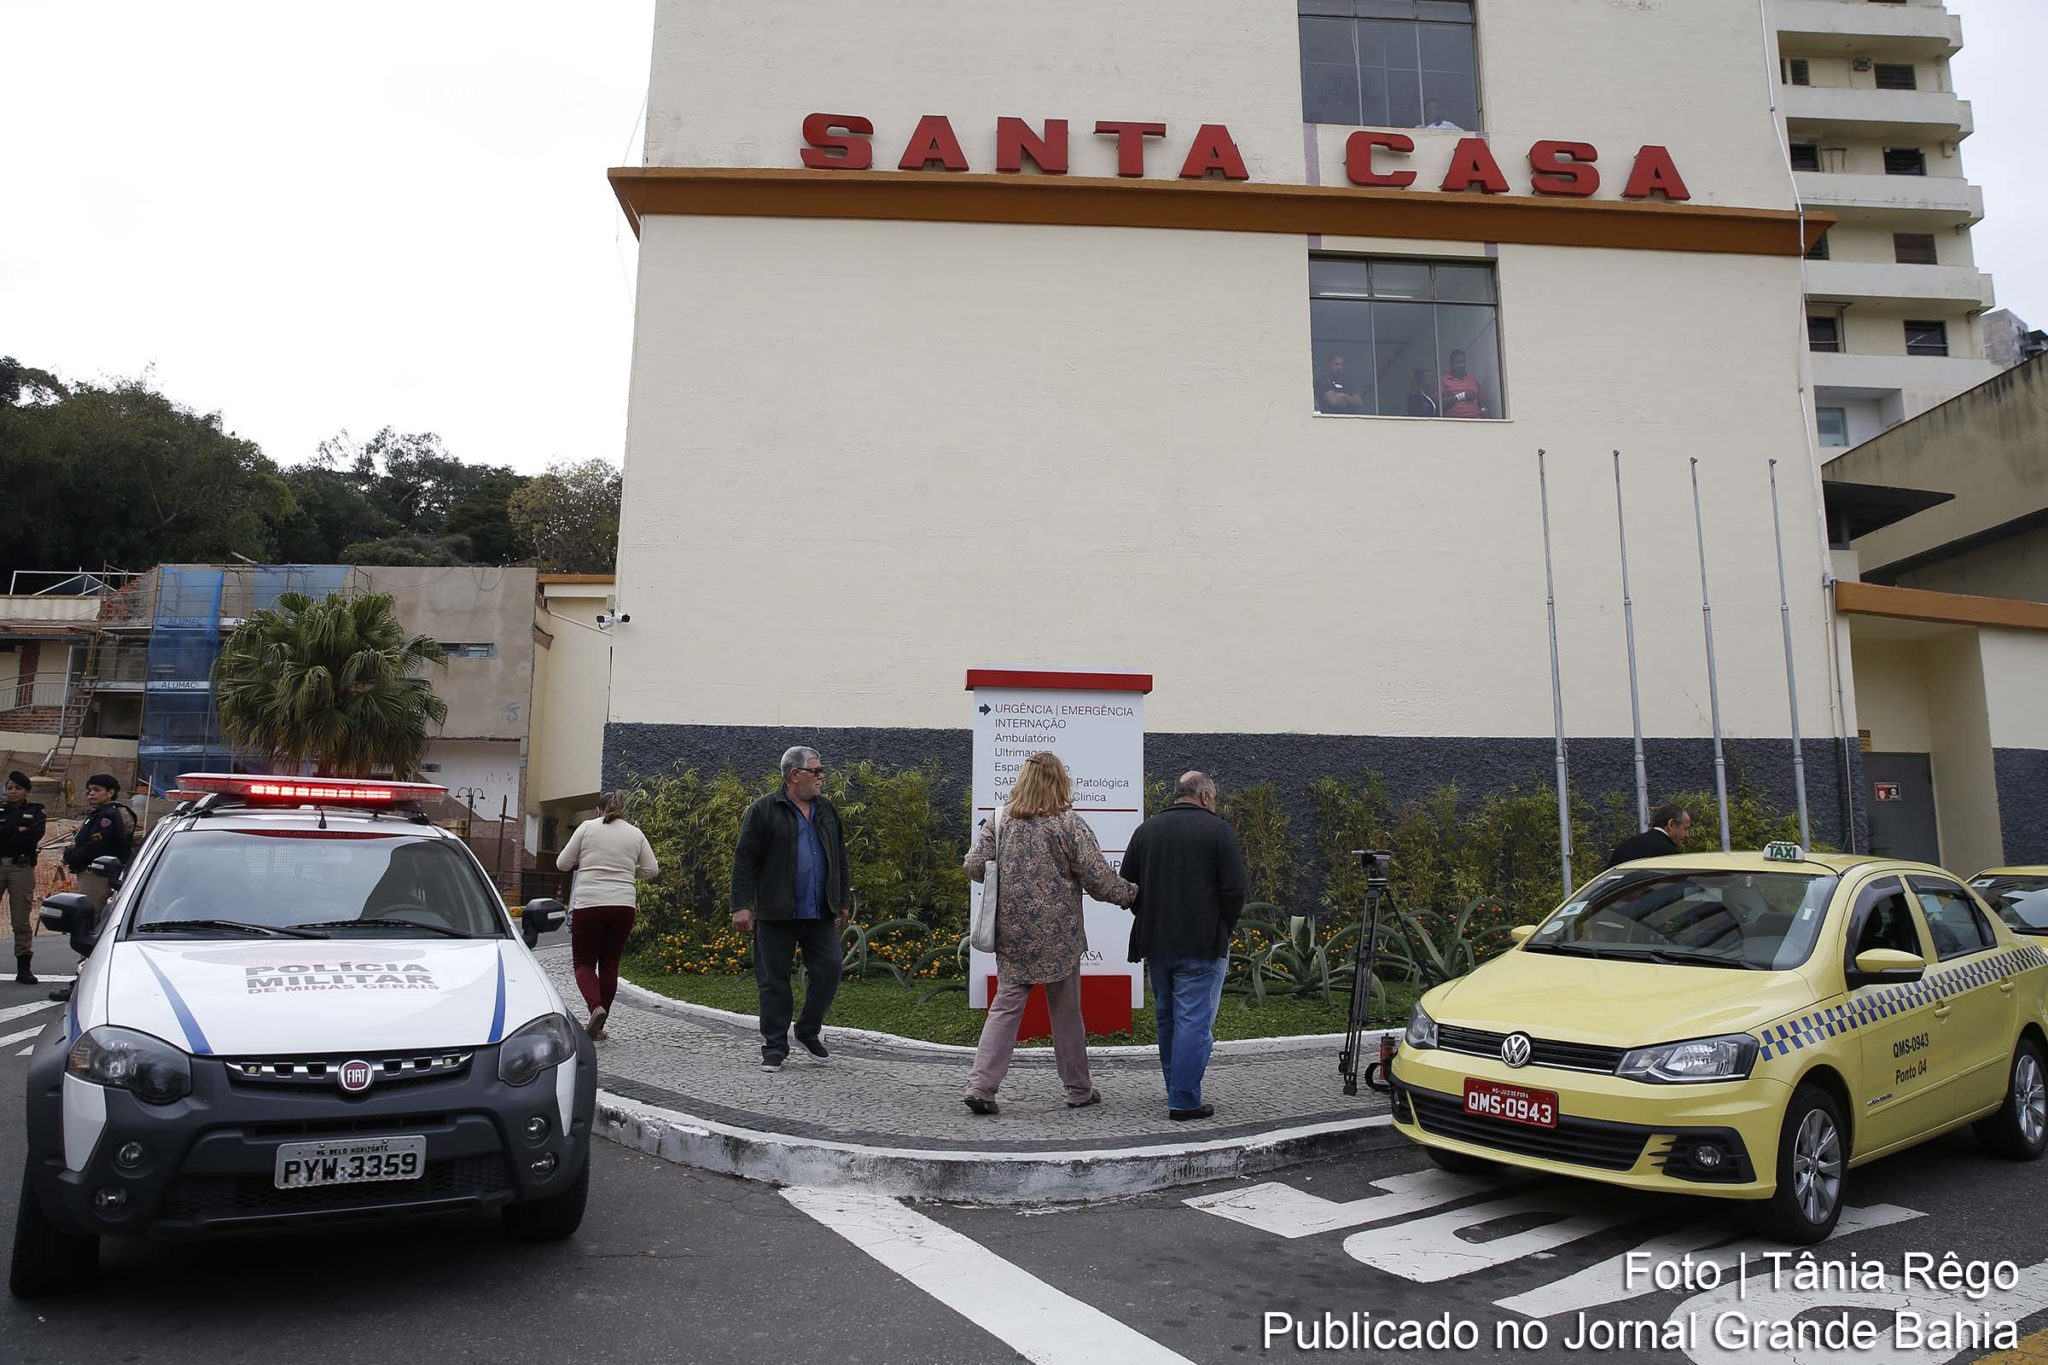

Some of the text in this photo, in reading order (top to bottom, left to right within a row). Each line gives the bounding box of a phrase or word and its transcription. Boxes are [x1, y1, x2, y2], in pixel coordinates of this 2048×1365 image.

[800, 112, 1691, 201] SANTA CASA
[161, 681, 196, 689] ALUMAC
[995, 703, 1053, 714] URGÊNCIA
[1061, 704, 1134, 717] EMERGÊNCIA
[995, 718, 1067, 731] INTERNAÇÃO
[994, 733, 1056, 743] Ambulatório
[1076, 778, 1129, 789] Patológica
[1073, 792, 1106, 802] Clínica
[1768, 845, 1797, 859] TAXI
[1081, 950, 1103, 960] ASA
[245, 961, 430, 976] POLÍCIA
[247, 974, 435, 988] MILITAR
[285, 984, 355, 992] MINAS
[1893, 1032, 1930, 1058] QMS-0943
[347, 1068, 366, 1083] FIAT
[1895, 1058, 1927, 1085] Ponto 04
[351, 1145, 389, 1153] HORIZONTE
